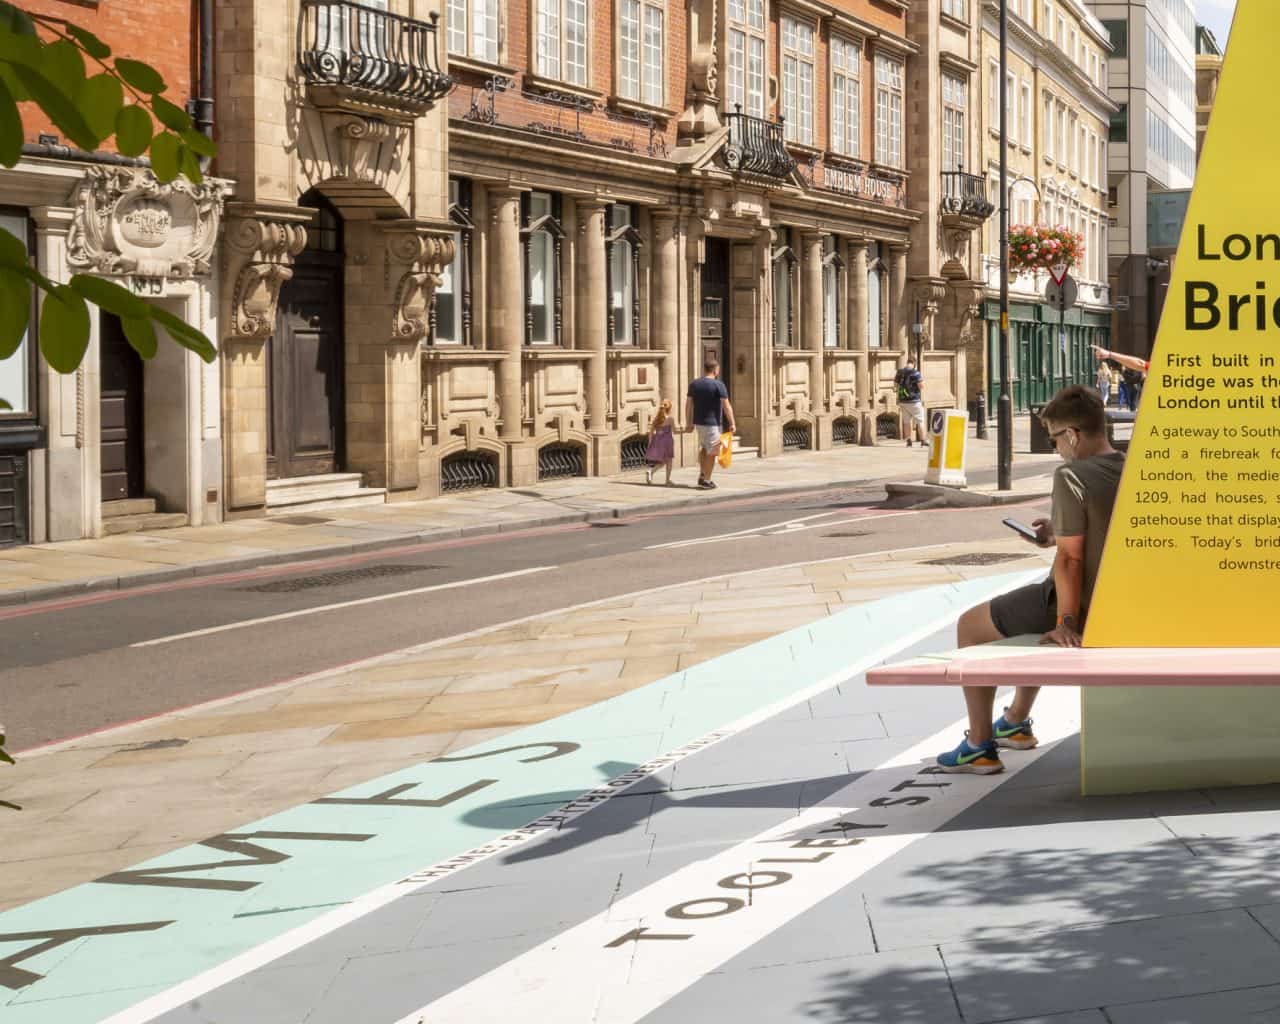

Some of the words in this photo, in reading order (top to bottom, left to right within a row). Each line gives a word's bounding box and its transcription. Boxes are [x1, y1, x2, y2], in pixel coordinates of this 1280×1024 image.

[824, 166, 860, 195] EMBLEM
[863, 176, 891, 198] HOUSE
[1167, 353, 1202, 368] First
[1212, 353, 1249, 368] built
[1259, 353, 1275, 368] in
[1162, 374, 1216, 392] Bridge
[1222, 377, 1255, 389] was
[1157, 394, 1221, 409] London
[1226, 394, 1265, 409] until
[1149, 424, 1160, 438] A
[1162, 427, 1220, 440] gateway
[1223, 427, 1238, 438] to
[1144, 447, 1171, 460] and
[1181, 450, 1189, 460] a
[1199, 447, 1260, 460] firebreak
[1140, 469, 1197, 484] London,
[1206, 470, 1228, 481] the
[1135, 490, 1172, 505] 1209,
[1181, 491, 1207, 504] had
[1215, 491, 1267, 505] houses,
[1129, 512, 1203, 529] gatehouse
[1205, 513, 1234, 529] that
[1125, 535, 1178, 549] traitors.
[1190, 535, 1242, 551] Today's
[396, 844, 509, 885] THAME
[603, 821, 889, 948] TOOLEY
